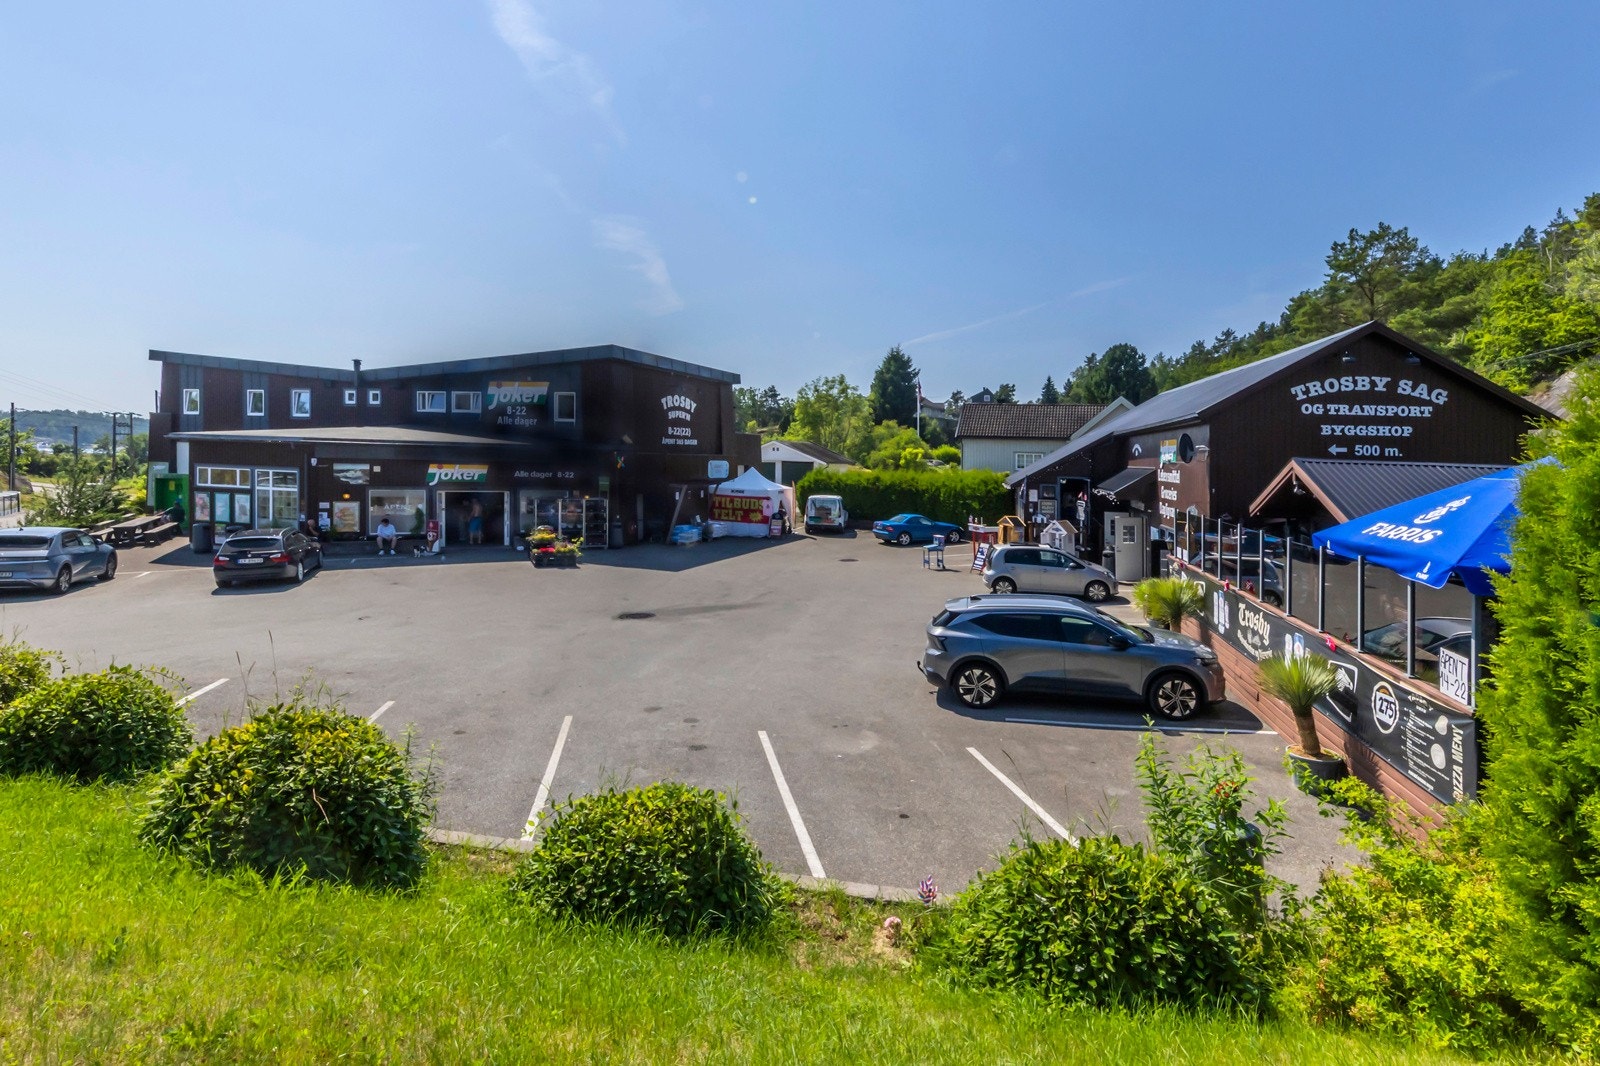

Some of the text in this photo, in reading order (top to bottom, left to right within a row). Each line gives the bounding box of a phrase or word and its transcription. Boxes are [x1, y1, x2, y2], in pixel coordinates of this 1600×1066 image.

[1290, 376, 1449, 405] TROSBY SAG
[506, 405, 527, 415] 8-22
[661, 394, 697, 413] TROSBY
[1301, 403, 1433, 417] OG TRANSPORT
[497, 416, 538, 427] Alle dager
[1320, 424, 1413, 437] BYGGSHOP
[1354, 445, 1403, 457] 500 m.
[514, 470, 529, 478] Alle
[530, 471, 553, 479] dager
[714, 508, 743, 520] TELT
[1362, 522, 1443, 544] FARRIS
[1238, 602, 1271, 646] Trosby
[1440, 671, 1466, 700] 14-22
[1378, 697, 1396, 719] 275
[1451, 724, 1464, 764] MENY
